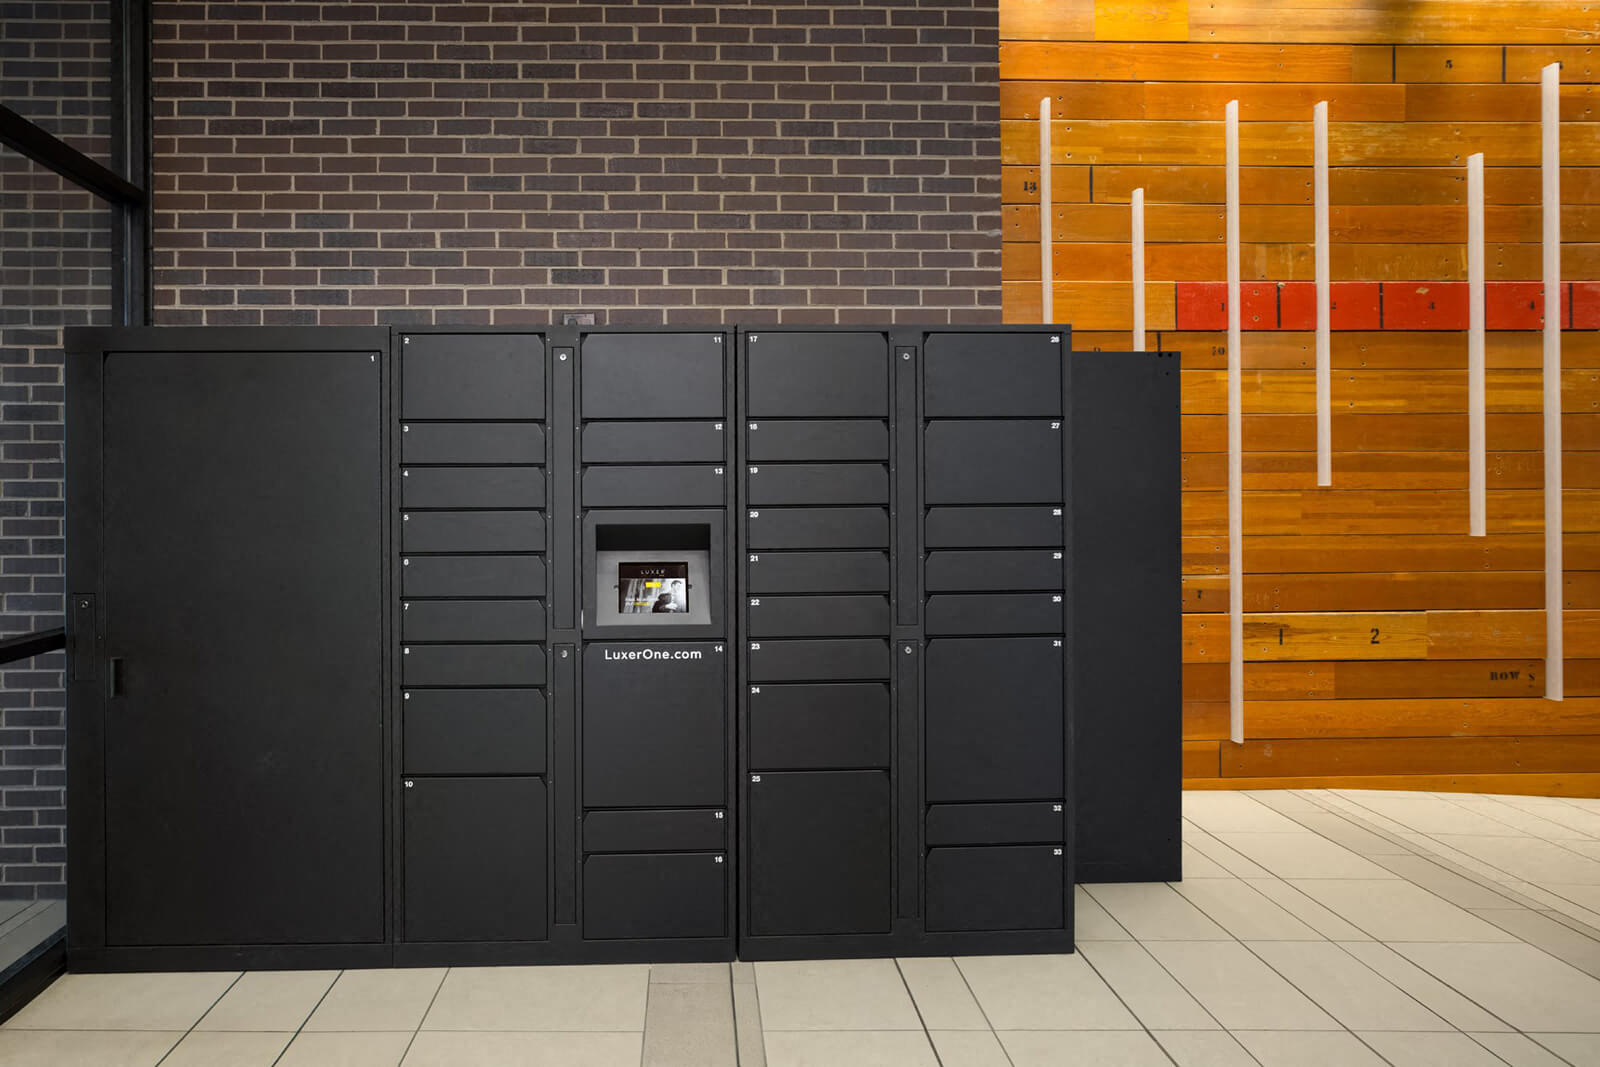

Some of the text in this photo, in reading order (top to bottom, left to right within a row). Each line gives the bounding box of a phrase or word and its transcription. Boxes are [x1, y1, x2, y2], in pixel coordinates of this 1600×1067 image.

[402, 337, 410, 345] 2
[713, 336, 722, 344] 11
[748, 335, 758, 343] 17
[402, 425, 409, 433] 3
[714, 423, 723, 431] 12
[714, 467, 724, 475] 13
[749, 466, 759, 474] 19
[749, 510, 760, 519] 20
[749, 554, 759, 562] 21
[1053, 552, 1063, 560] 29
[402, 558, 410, 566] 6
[750, 598, 760, 606] 22
[1052, 595, 1062, 603] 30
[1370, 628, 1380, 645] 2
[714, 645, 723, 653] 14
[751, 642, 761, 650] 23
[604, 648, 702, 661] LuxerOne.com
[1490, 671, 1521, 681] ROW
[751, 686, 761, 694] 24
[403, 692, 410, 700] 9
[751, 775, 761, 783] 25
[404, 780, 414, 788] 10
[1053, 804, 1062, 812] 32
[715, 811, 724, 819] 15
[1053, 848, 1063, 856] 33
[714, 855, 723, 863] 16
